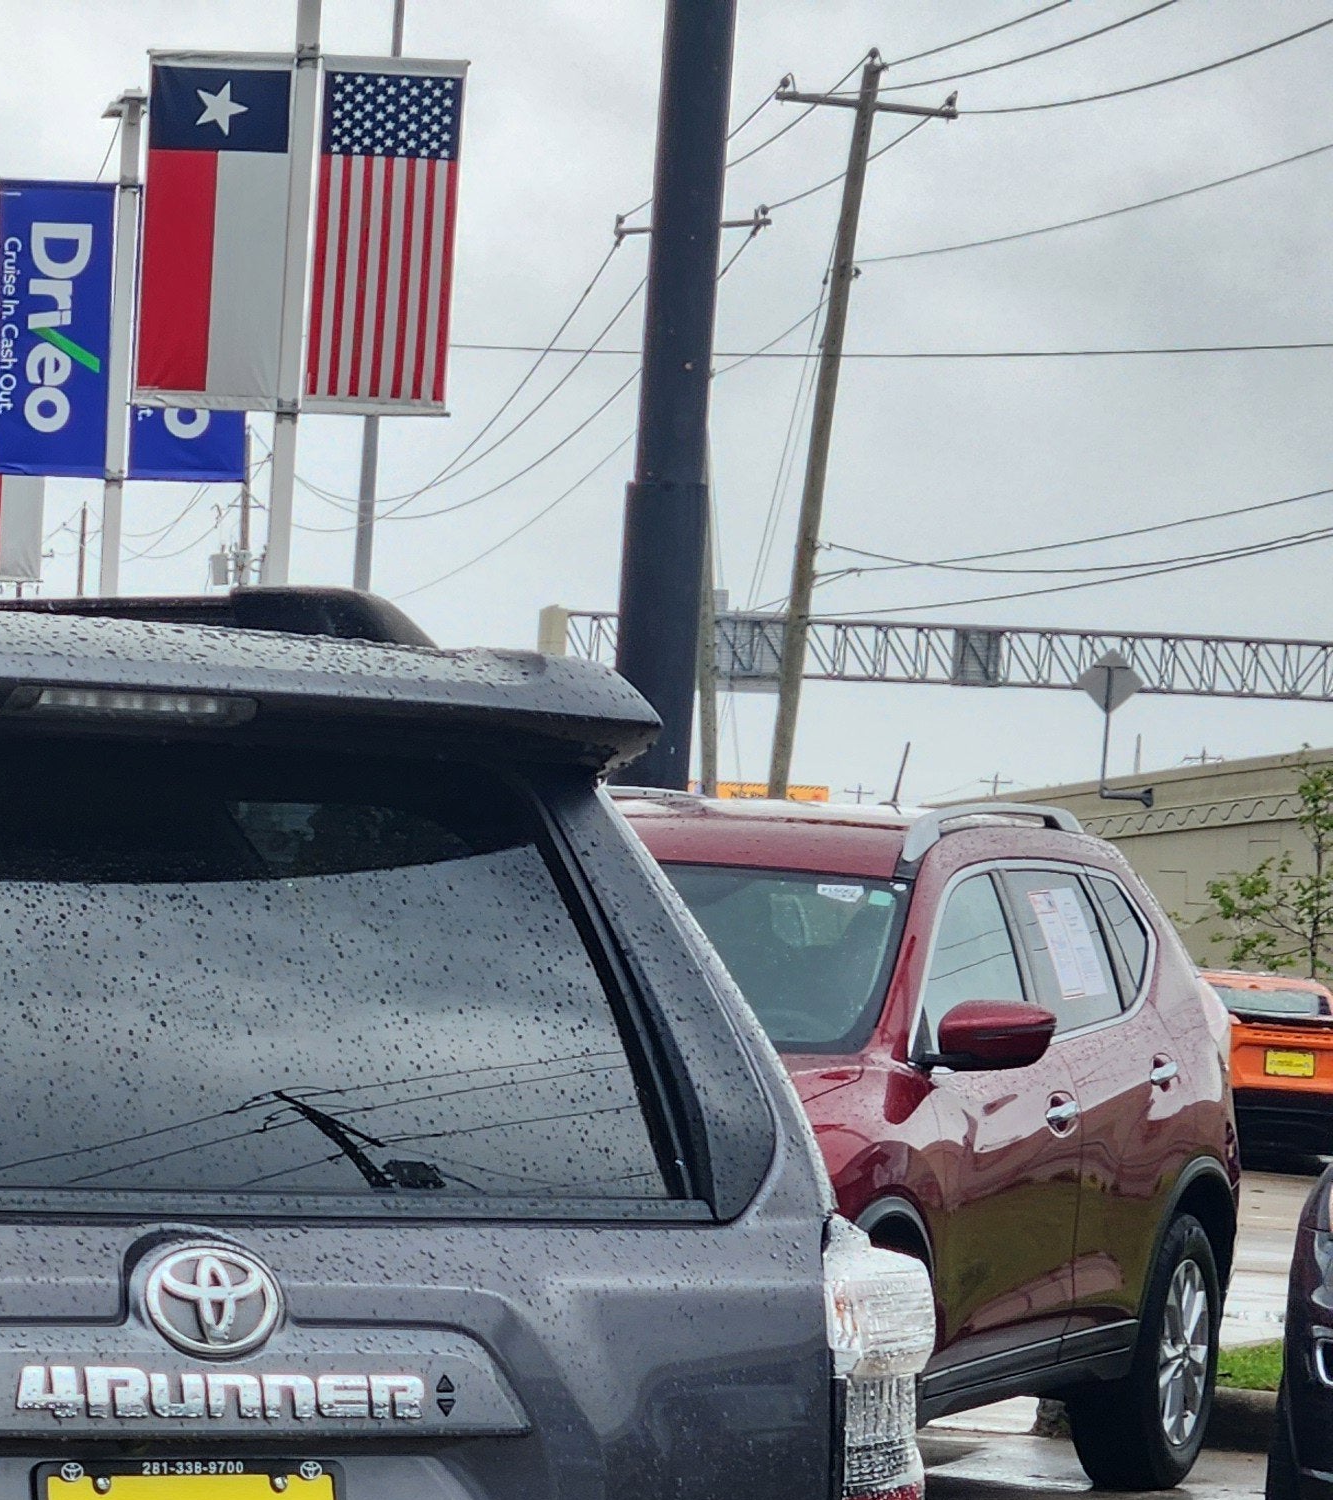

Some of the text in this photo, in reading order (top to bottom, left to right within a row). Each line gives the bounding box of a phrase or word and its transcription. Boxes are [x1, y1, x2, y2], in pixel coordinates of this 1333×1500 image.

[2, 236, 23, 297] Cruise
[0, 298, 21, 320] In.
[141, 1460, 245, 1476] 281-338-9700
